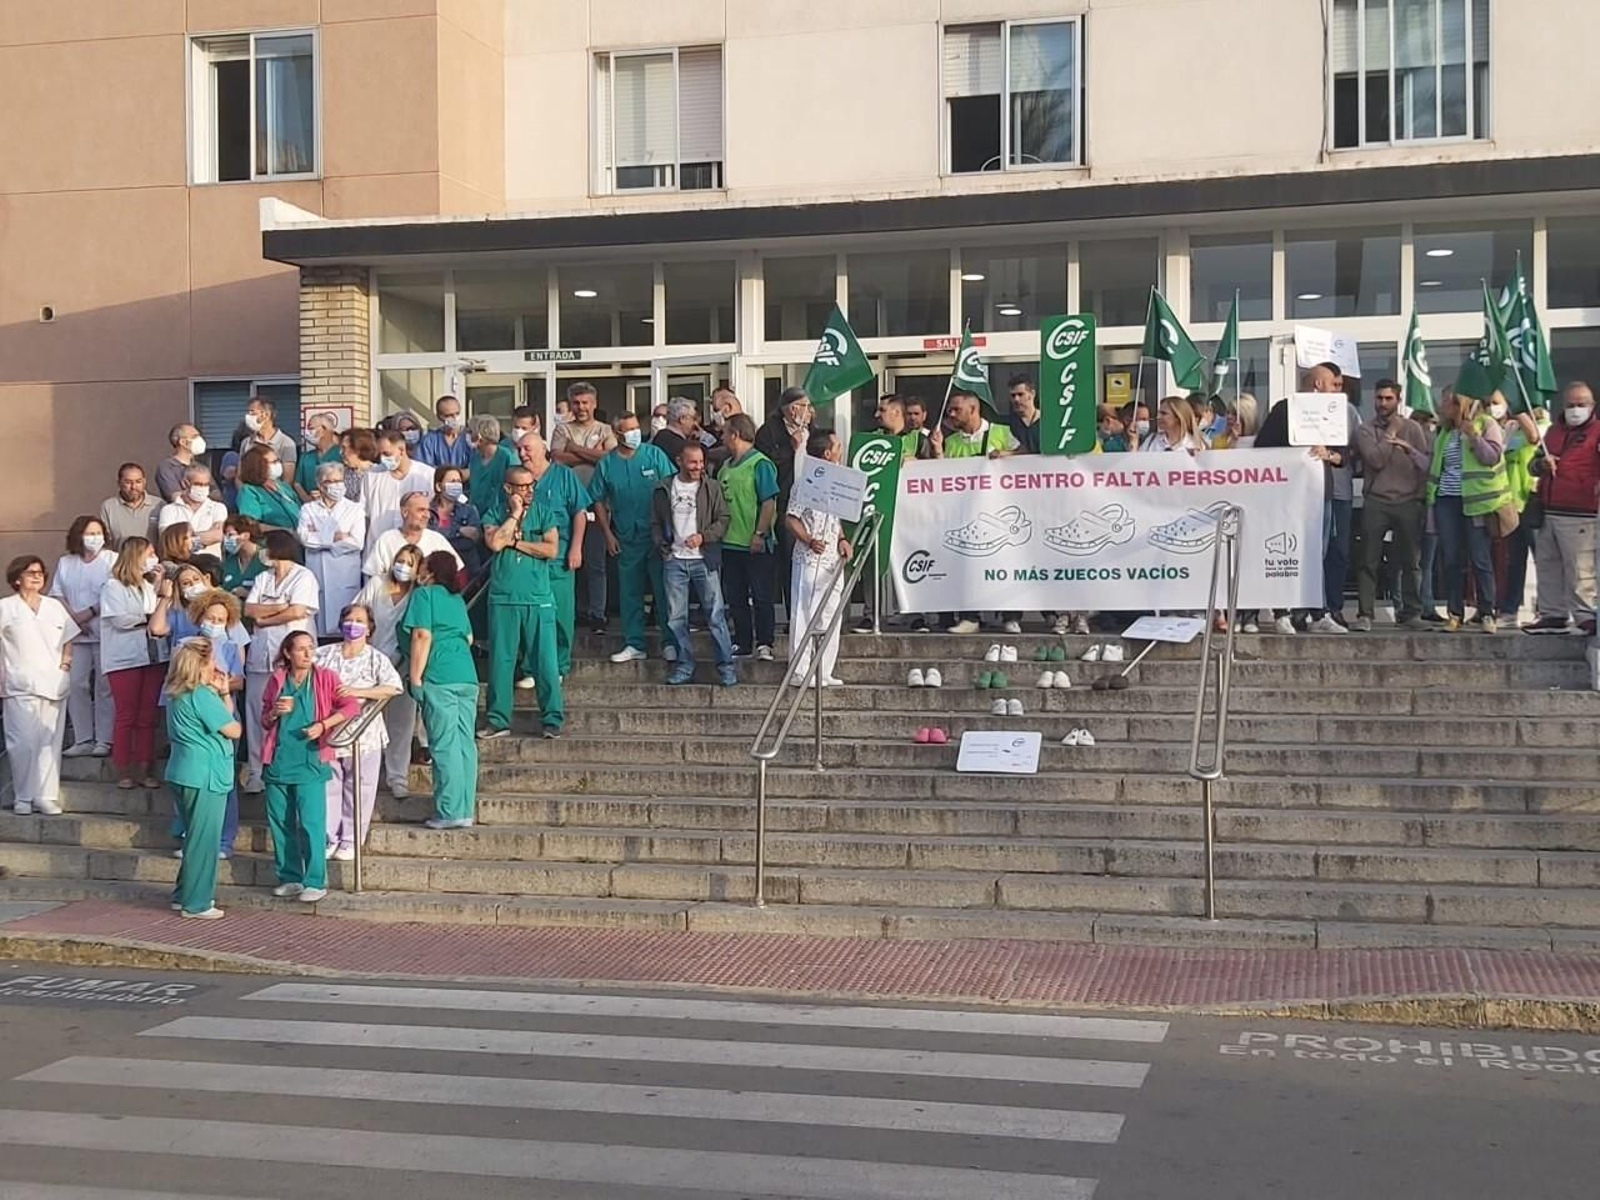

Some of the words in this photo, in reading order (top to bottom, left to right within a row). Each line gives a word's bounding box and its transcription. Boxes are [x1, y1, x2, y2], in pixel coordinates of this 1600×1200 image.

[530, 351, 575, 361] ENTRADA
[906, 478, 934, 494] EN
[941, 475, 992, 492] ESTE
[999, 472, 1085, 490] CENTRO
[1092, 471, 1161, 488] FALTA
[1167, 467, 1289, 487] PERSONAL
[984, 569, 1008, 581] NO
[1013, 565, 1049, 581] MÁS
[1053, 568, 1121, 581] ZUECOS
[1126, 564, 1190, 580] VACÍOS
[1219, 1045, 1277, 1058] En
[1294, 1050, 1398, 1064] todo
